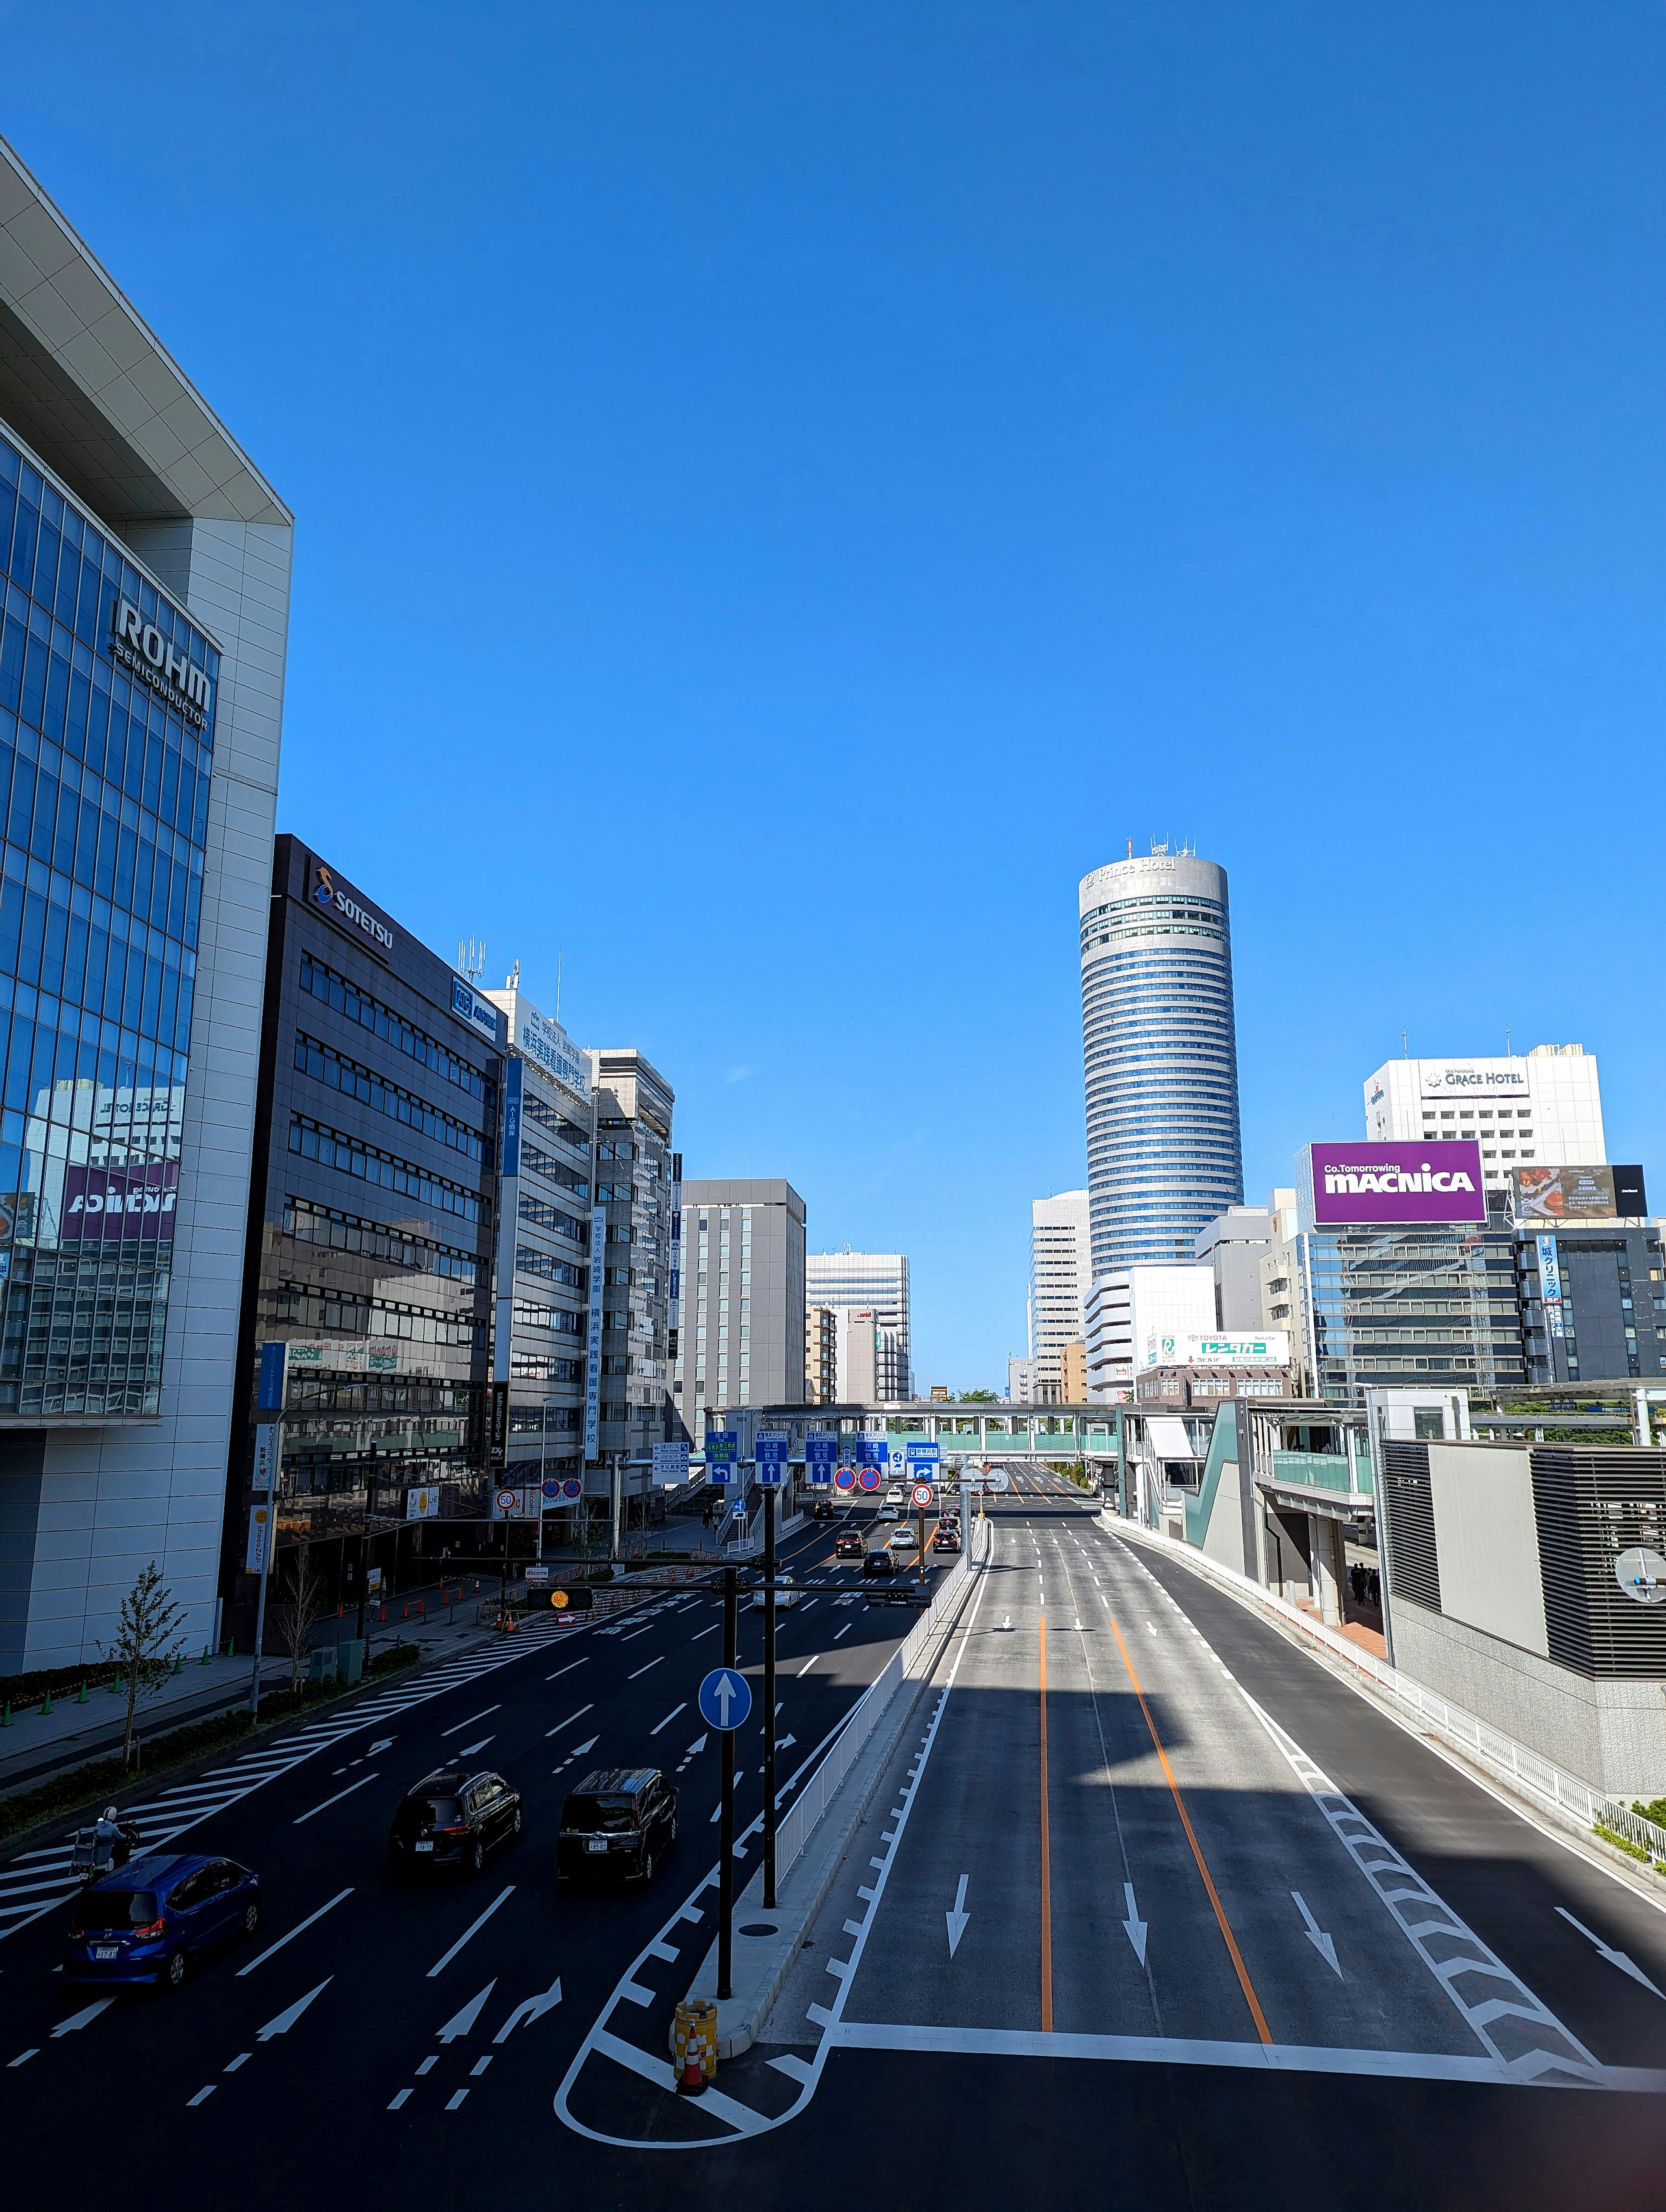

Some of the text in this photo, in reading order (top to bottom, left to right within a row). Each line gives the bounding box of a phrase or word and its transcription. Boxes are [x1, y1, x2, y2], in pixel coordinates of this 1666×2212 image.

[118, 599, 211, 713] ROHM
[116, 642, 208, 731] SEMICONDUCTOR
[1099, 857, 1176, 883] Prince Hotel
[336, 890, 393, 949] SOTETSU
[457, 990, 471, 1012] AIG
[542, 1020, 580, 1066] 学校法人 岩崎学園
[523, 1024, 586, 1096] 横浜実践看護専門学校
[1445, 1073, 1524, 1087] GRACE HOTEL
[1324, 1163, 1401, 1173] Co.Tomorrowing
[592, 1256, 601, 1293] 岩崎学園
[1541, 1246, 1556, 1297] 城クリニック
[1205, 1343, 1265, 1353] レンタカー
[586, 1308, 600, 1443] 横浜実践看護専門学校
[491, 1446, 503, 1456] ZXY
[500, 1495, 511, 1504] 50
[917, 1490, 928, 1501] 50
